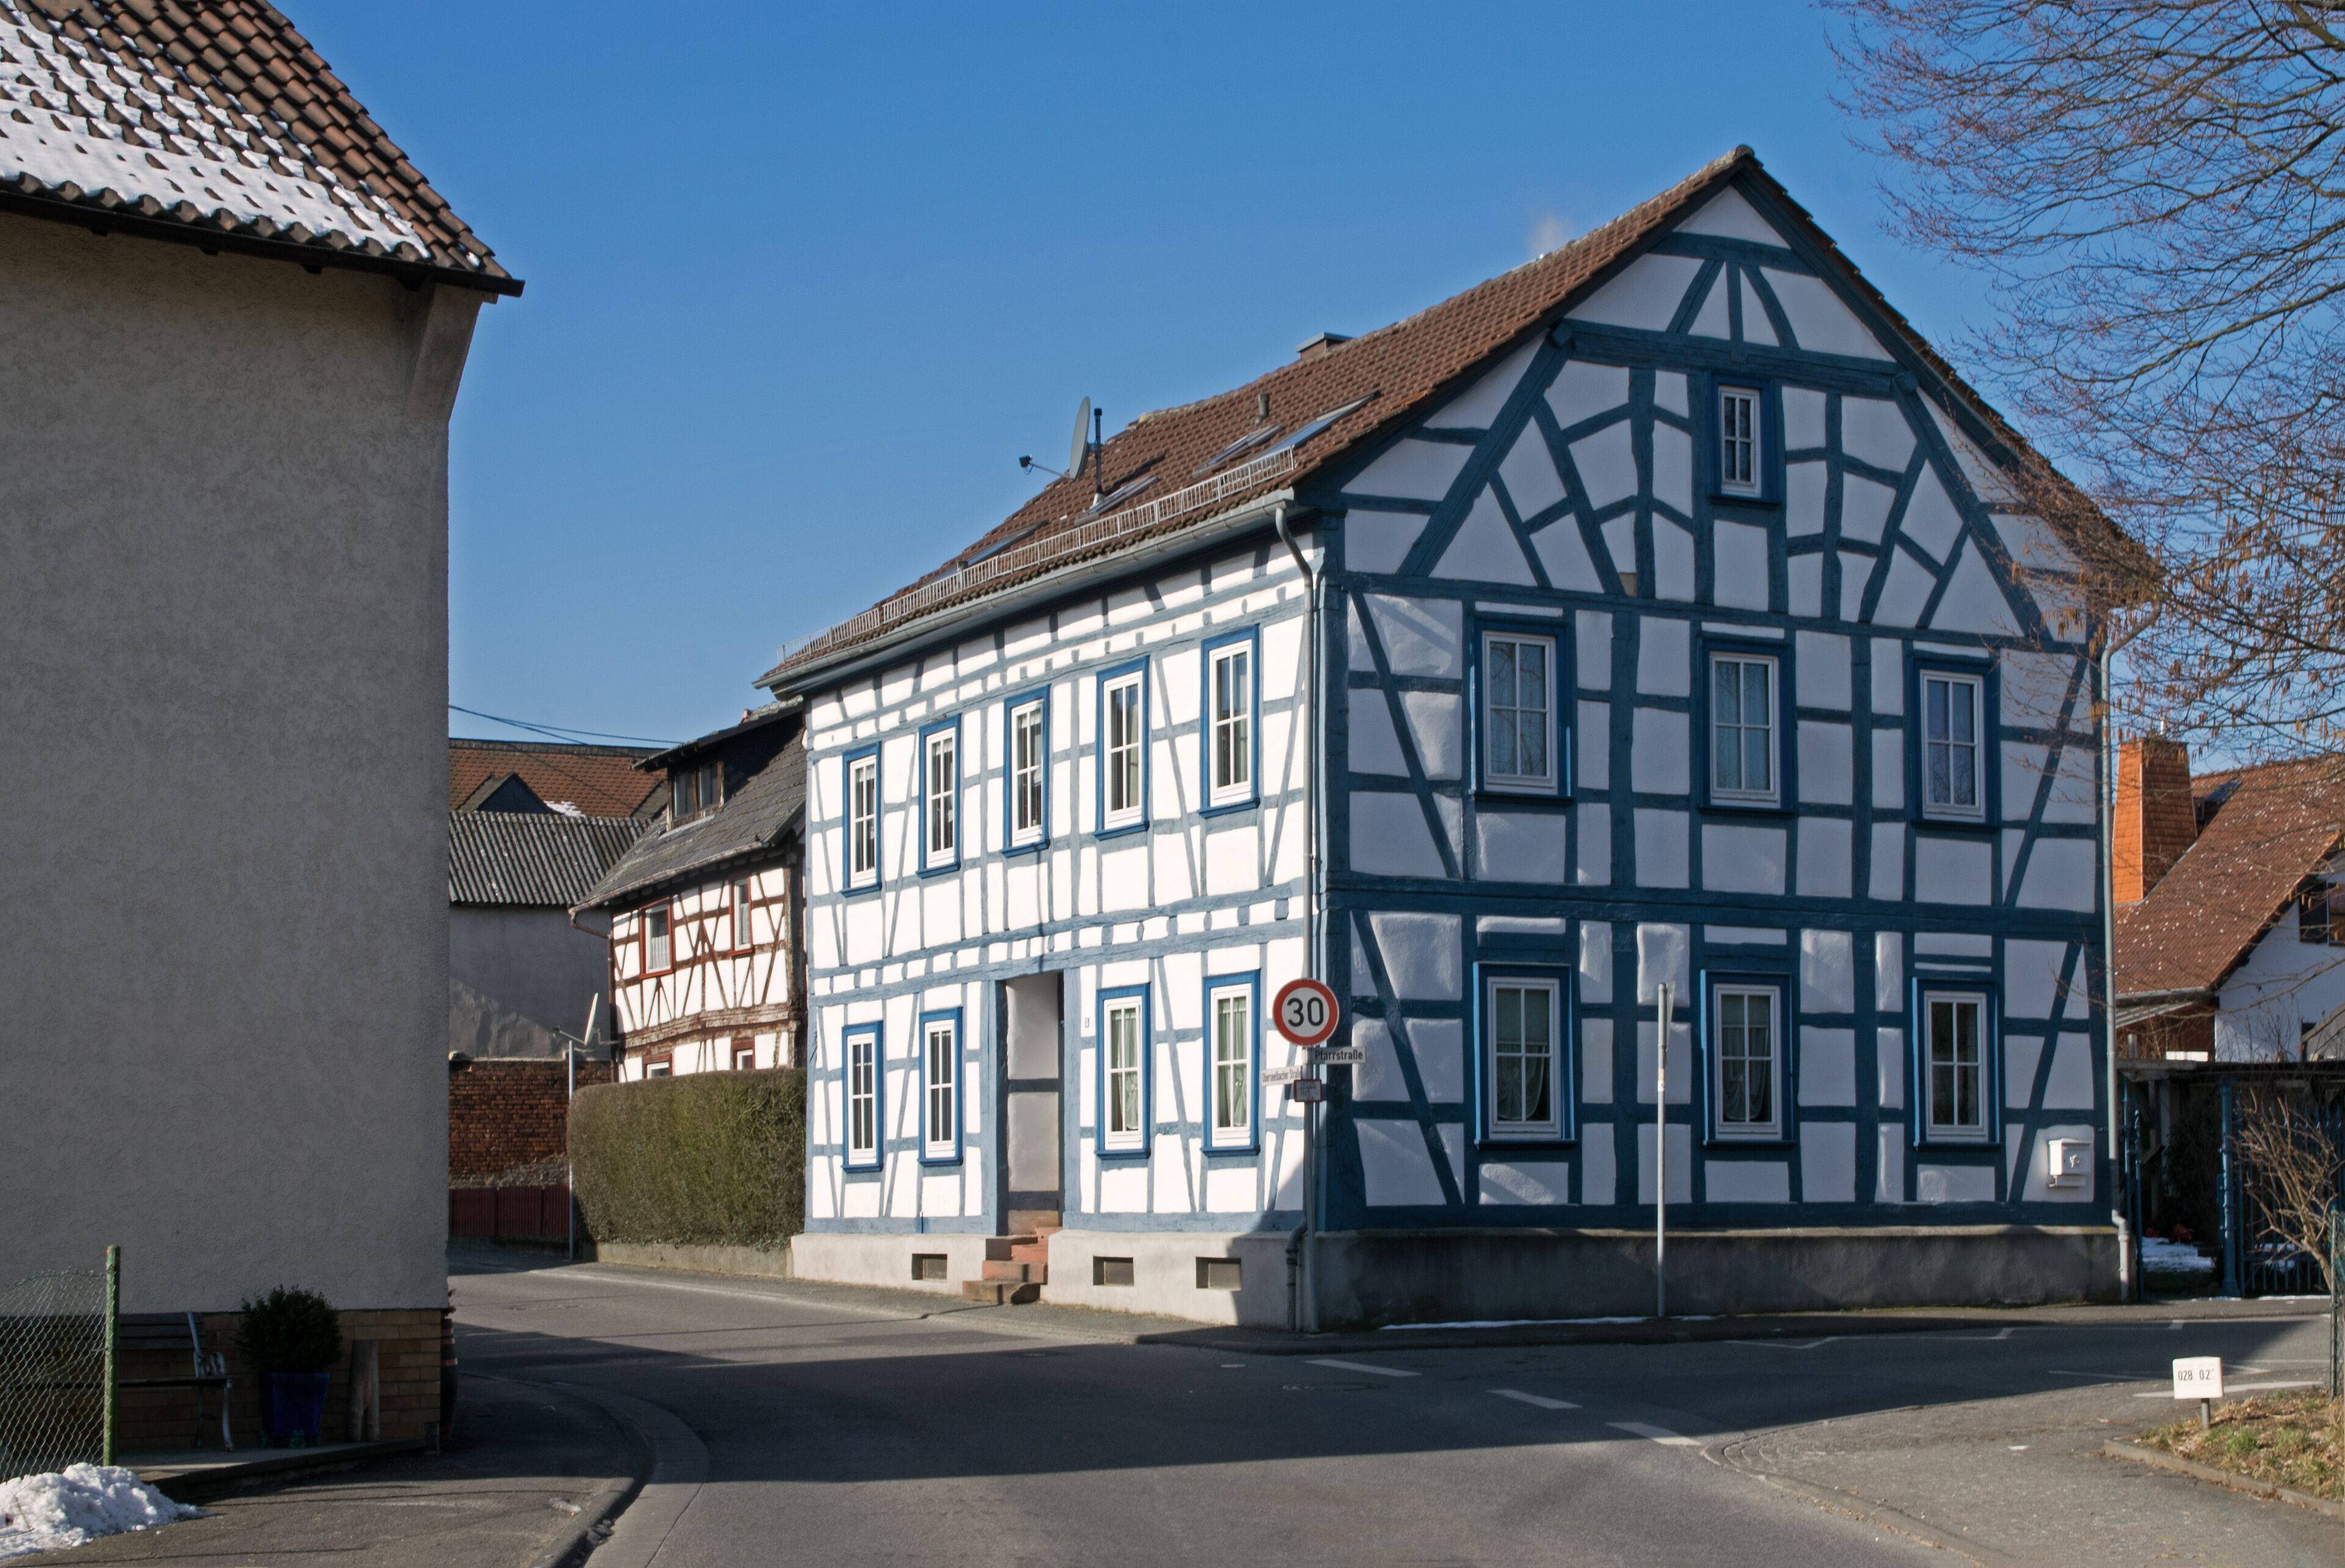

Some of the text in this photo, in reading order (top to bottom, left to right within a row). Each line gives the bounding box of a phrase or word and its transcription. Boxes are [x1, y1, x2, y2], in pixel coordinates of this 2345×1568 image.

[1287, 997, 1324, 1026] 30
[1315, 1049, 1363, 1061] Pfarrstraße
[2178, 1370, 2193, 1381] 028
